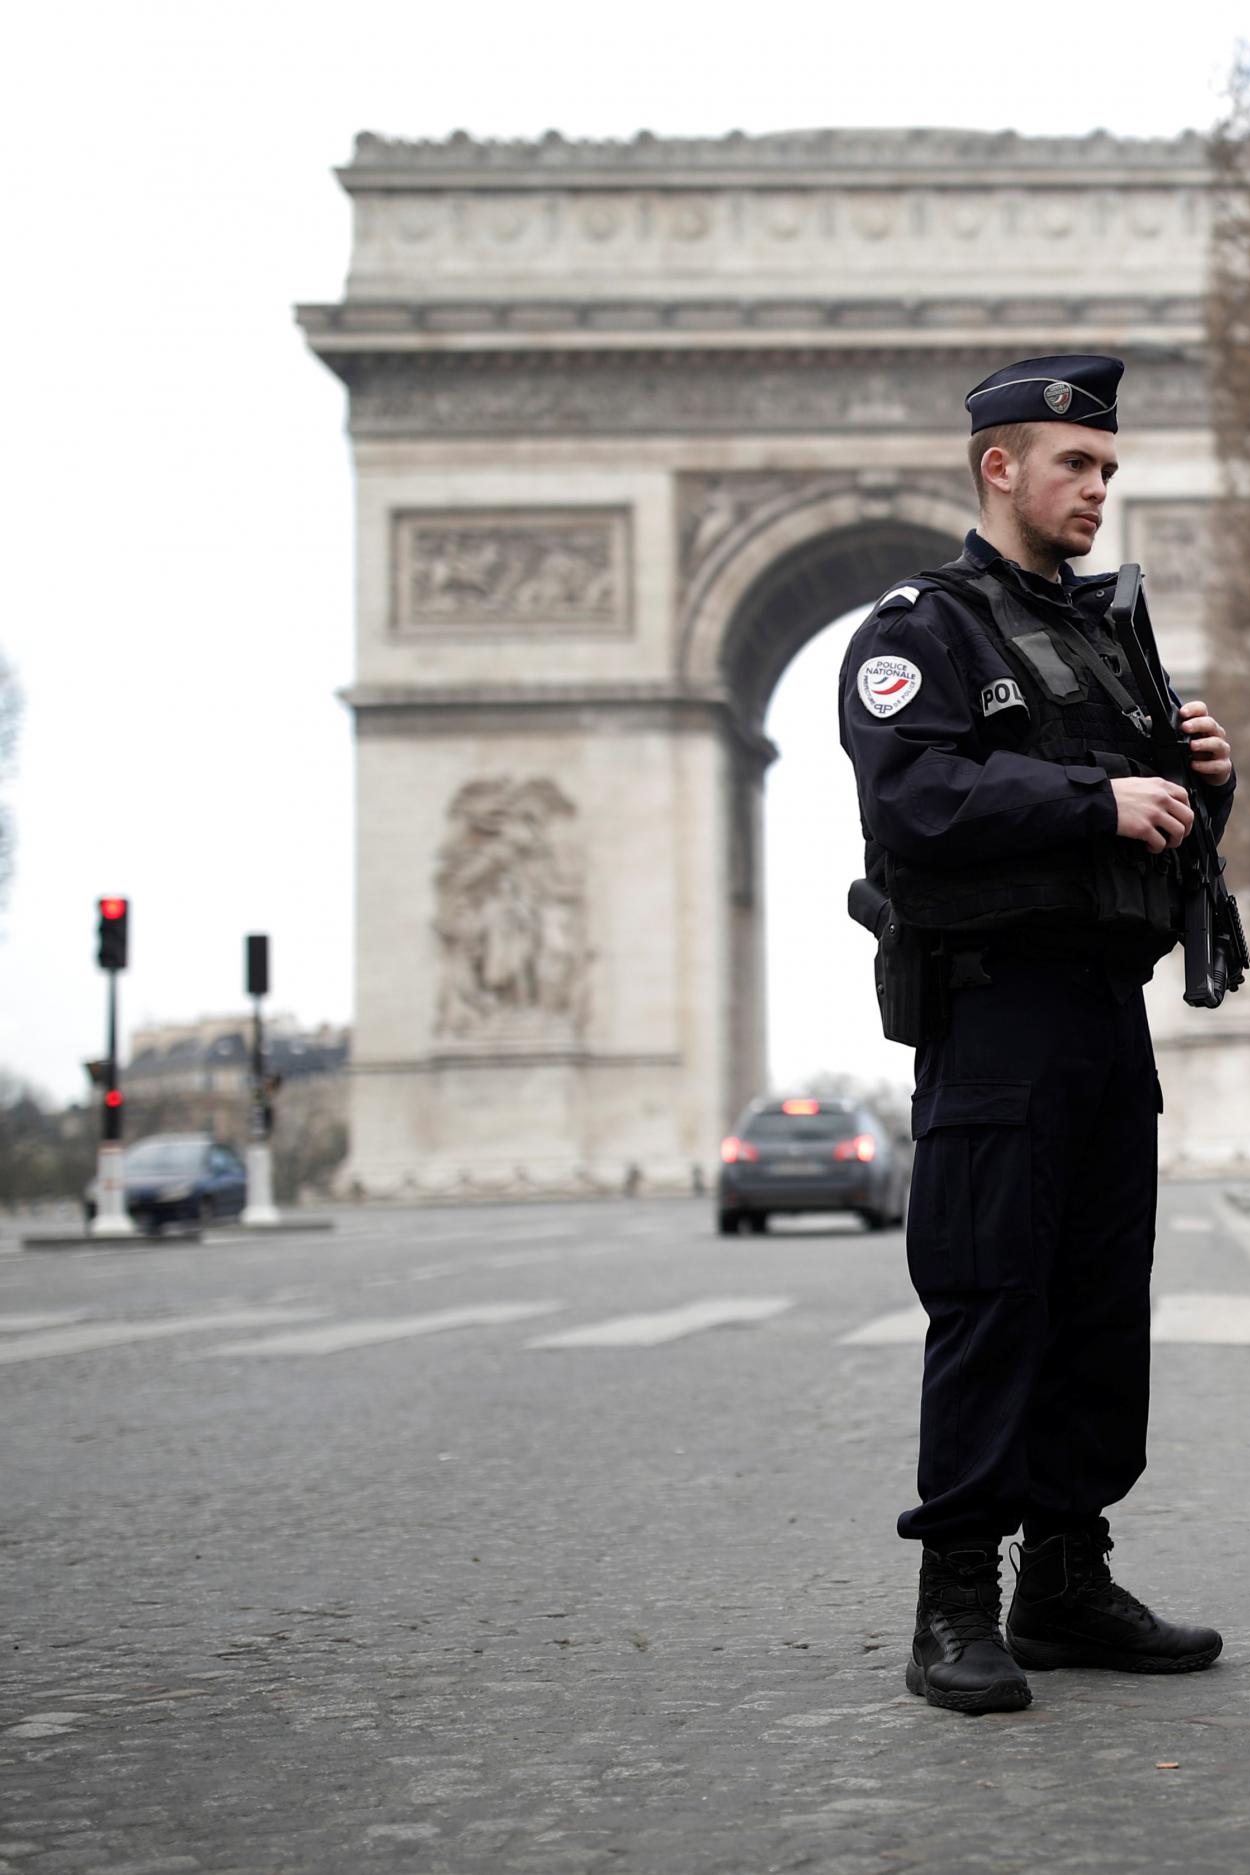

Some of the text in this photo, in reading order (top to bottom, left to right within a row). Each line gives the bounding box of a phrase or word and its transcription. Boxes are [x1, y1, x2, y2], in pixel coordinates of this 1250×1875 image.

[877, 661, 907, 671] POLICE
[866, 667, 916, 680] NATIONALE
[983, 683, 1023, 711] POL
